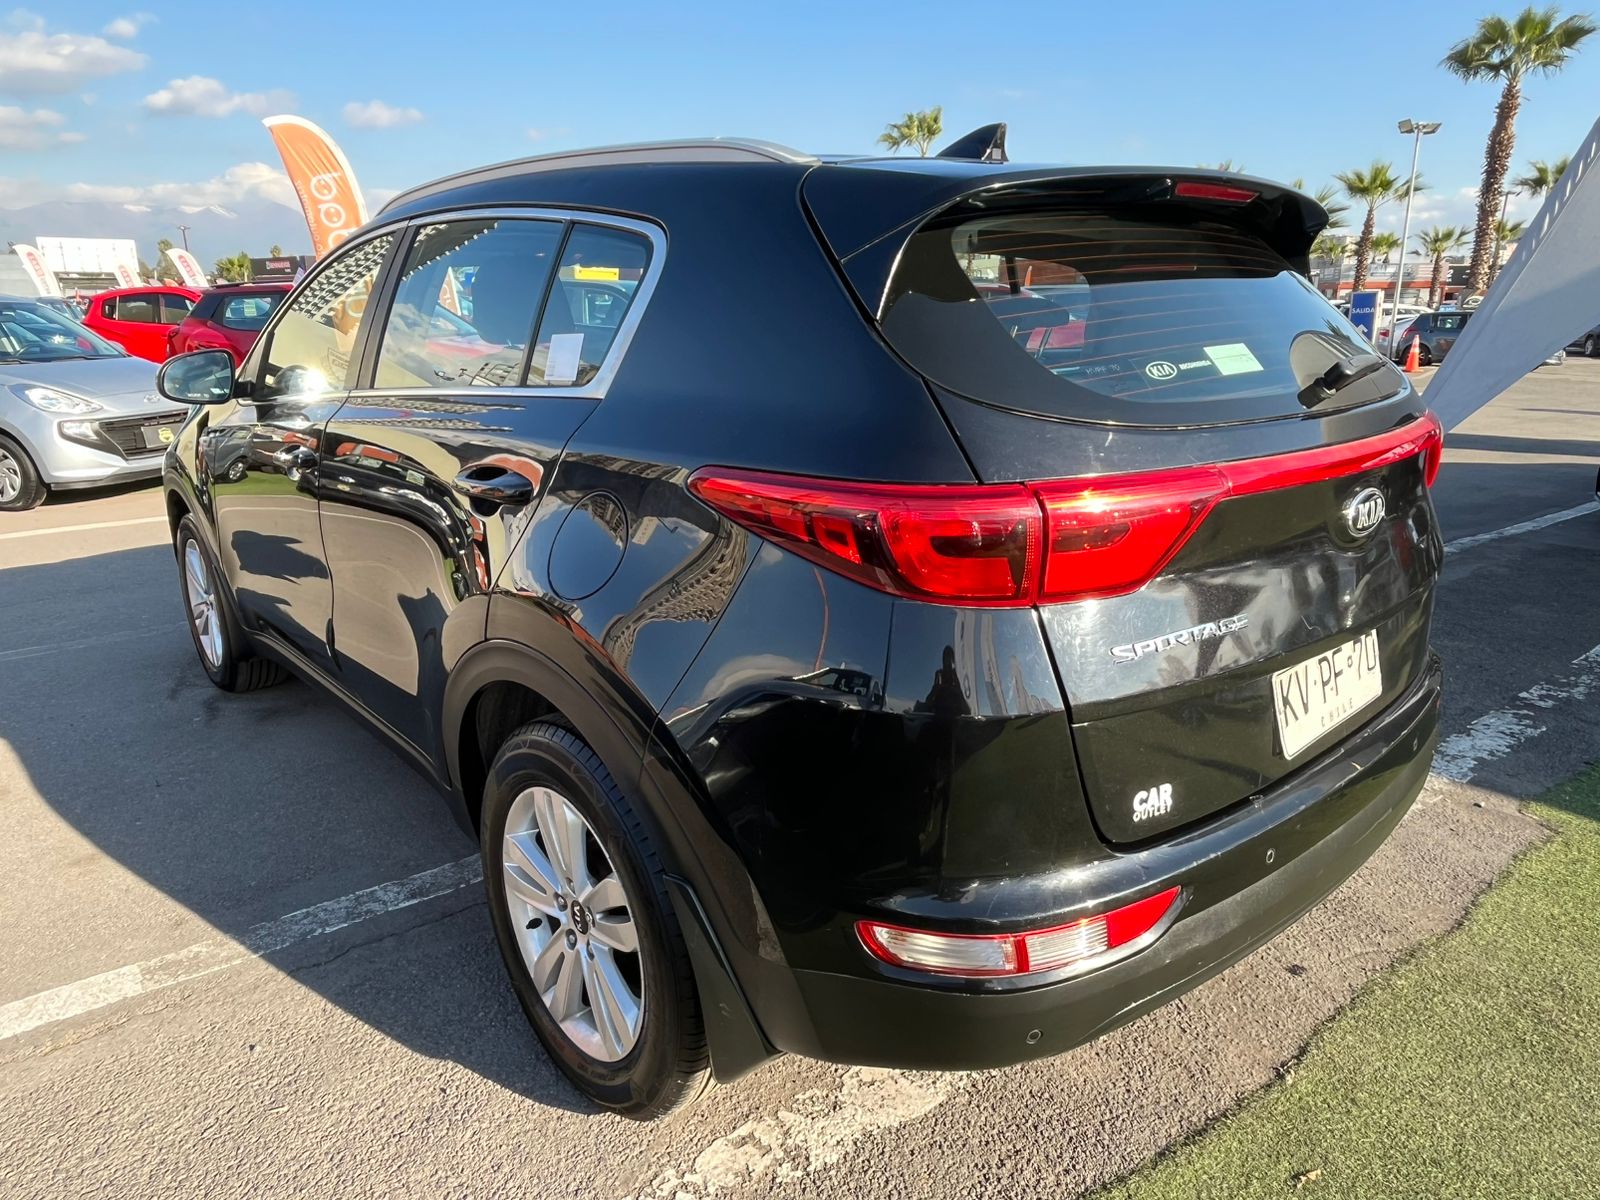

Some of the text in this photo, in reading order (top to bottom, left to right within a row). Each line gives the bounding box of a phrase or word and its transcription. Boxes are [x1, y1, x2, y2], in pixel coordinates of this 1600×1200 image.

[1352, 306, 1375, 314] SALIDA
[1149, 363, 1175, 378] KIA
[1108, 613, 1249, 663] SPORTAGE
[1321, 697, 1353, 728] CHILE
[1132, 783, 1172, 812] CAR
[1132, 803, 1171, 823] OUTLET
